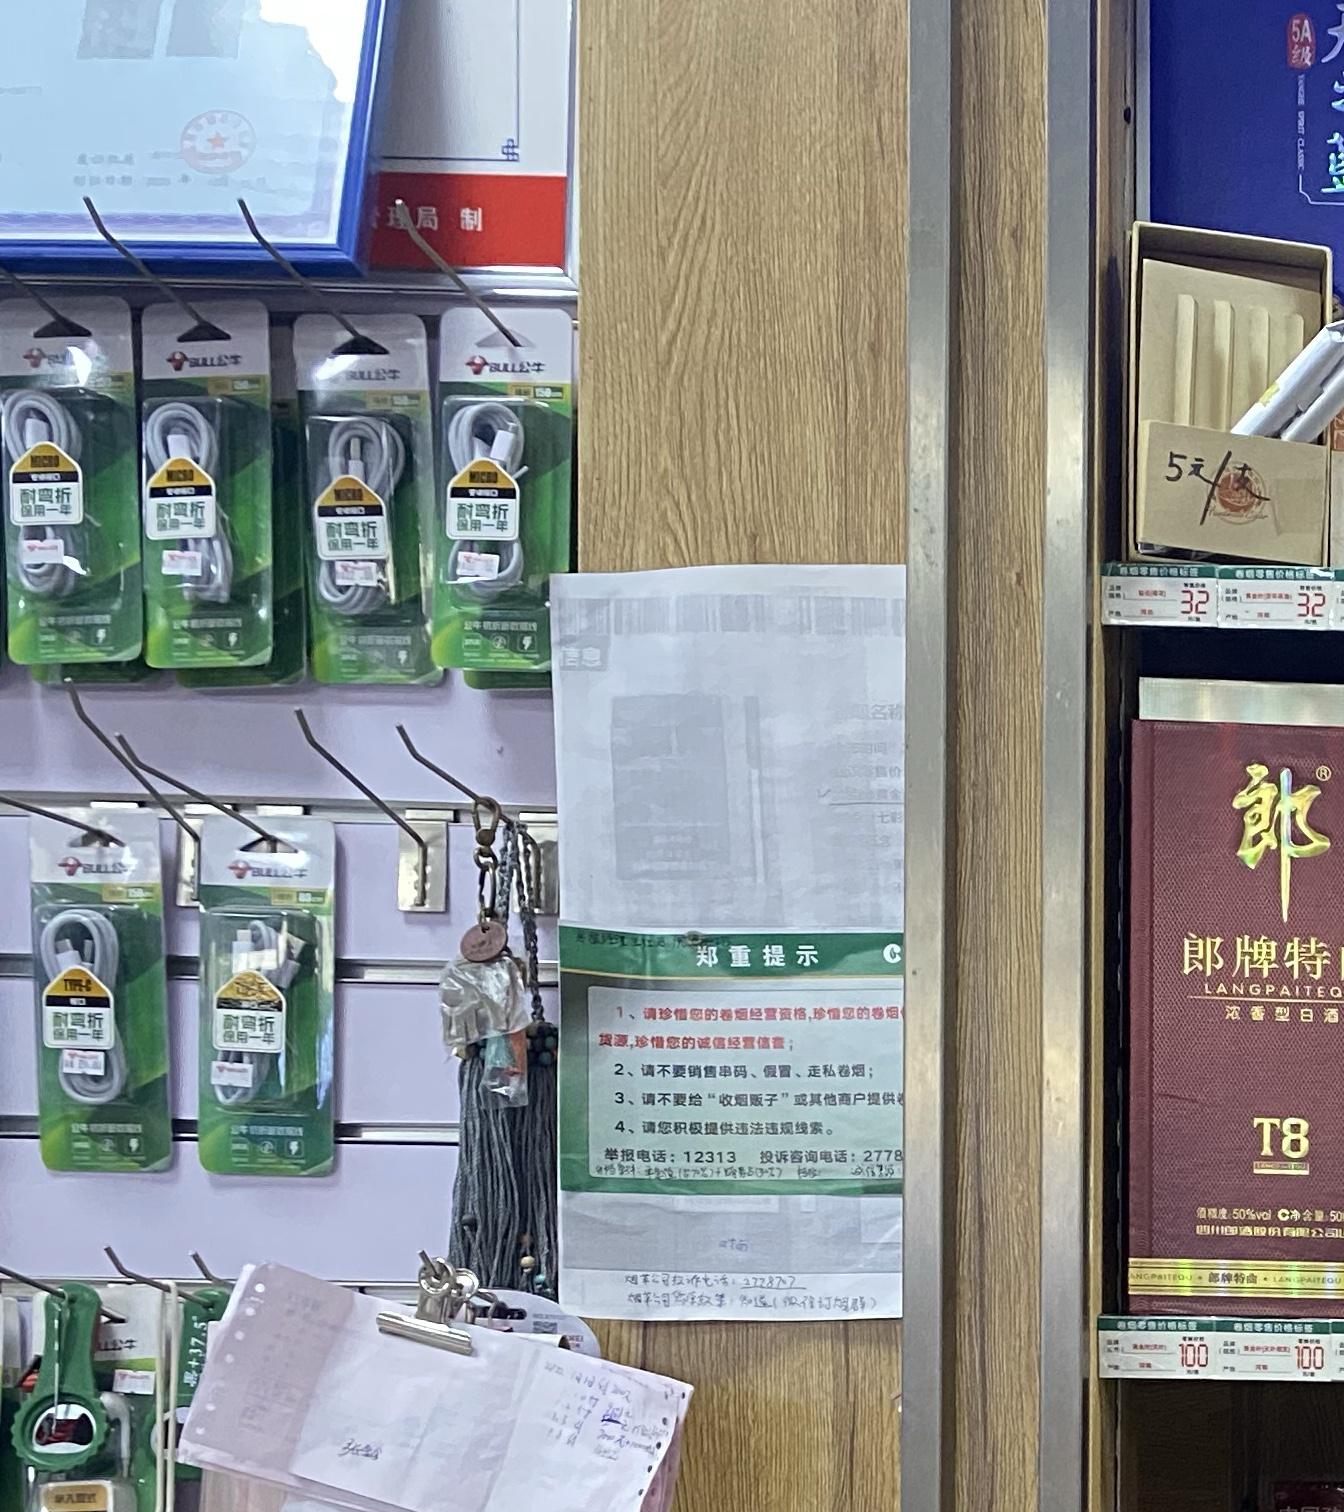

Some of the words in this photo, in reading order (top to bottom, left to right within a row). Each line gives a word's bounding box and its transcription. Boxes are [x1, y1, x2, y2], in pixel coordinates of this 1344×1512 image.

[460, 207, 483, 232] 制
[20, 488, 72, 505] 耐弯折
[457, 503, 509, 519] 耐弯折
[1181, 590, 1209, 615] 32
[1298, 592, 1326, 618] 32
[695, 944, 820, 968] 郑重提示
[1225, 1004, 1340, 1024] 浓香型白酒
[1253, 1116, 1309, 1158] T8
[1178, 1343, 1209, 1368] 100
[1294, 1346, 1325, 1370] 100
